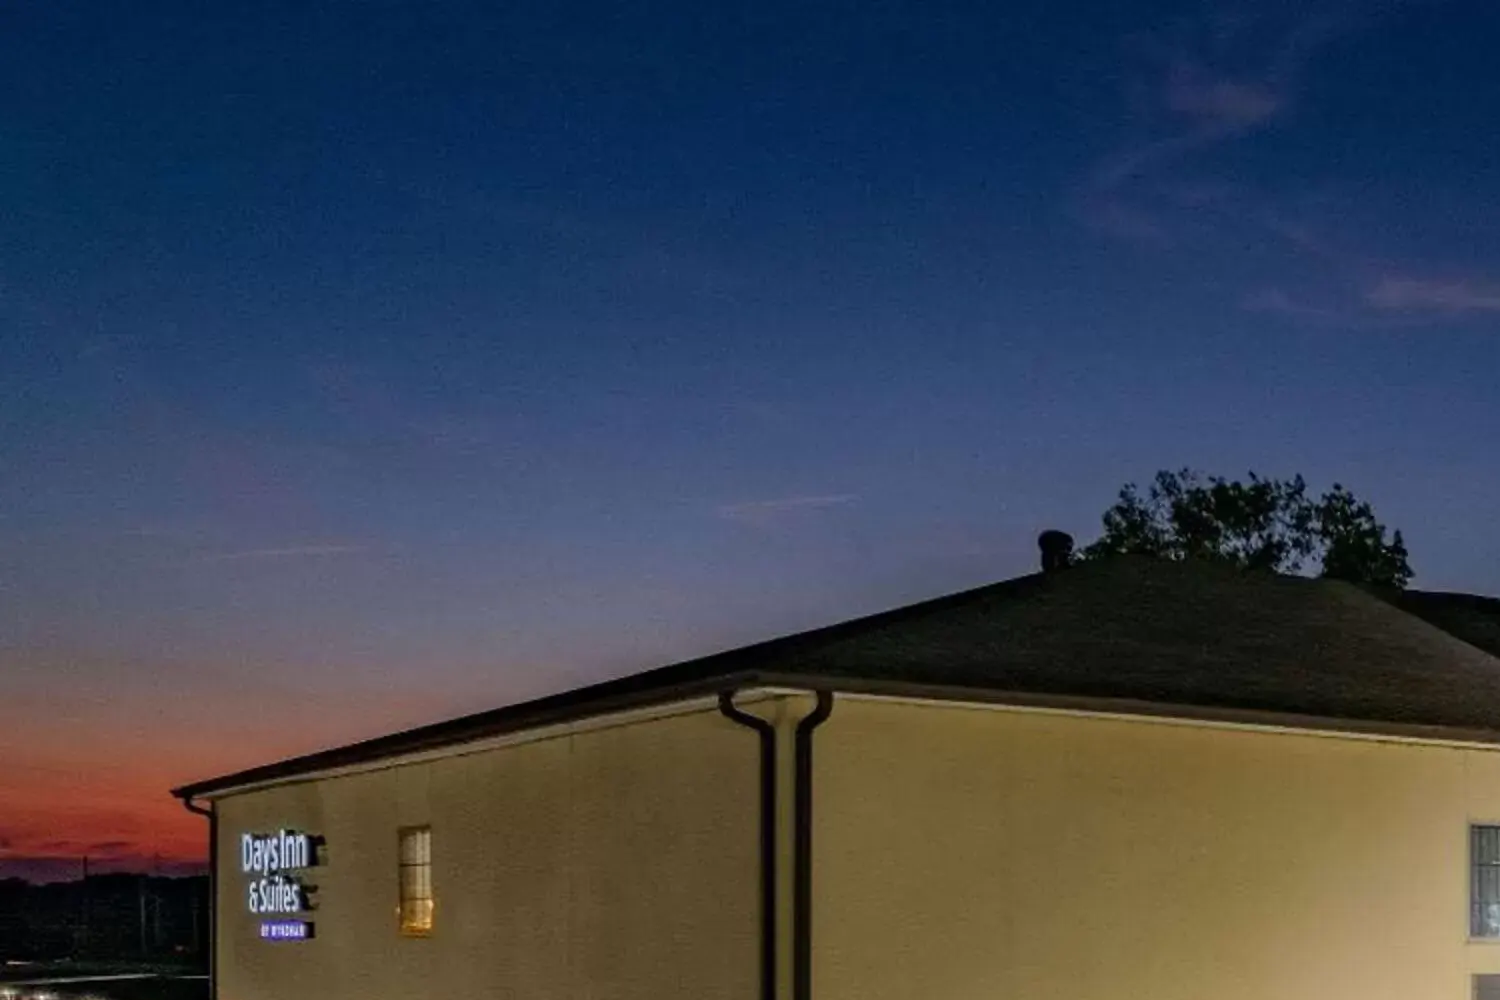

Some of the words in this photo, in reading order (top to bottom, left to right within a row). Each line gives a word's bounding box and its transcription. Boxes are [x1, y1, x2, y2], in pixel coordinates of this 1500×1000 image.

[241, 833, 279, 876] Days
[280, 829, 309, 869] Inn
[249, 881, 259, 913] &
[259, 876, 300, 913] Suites
